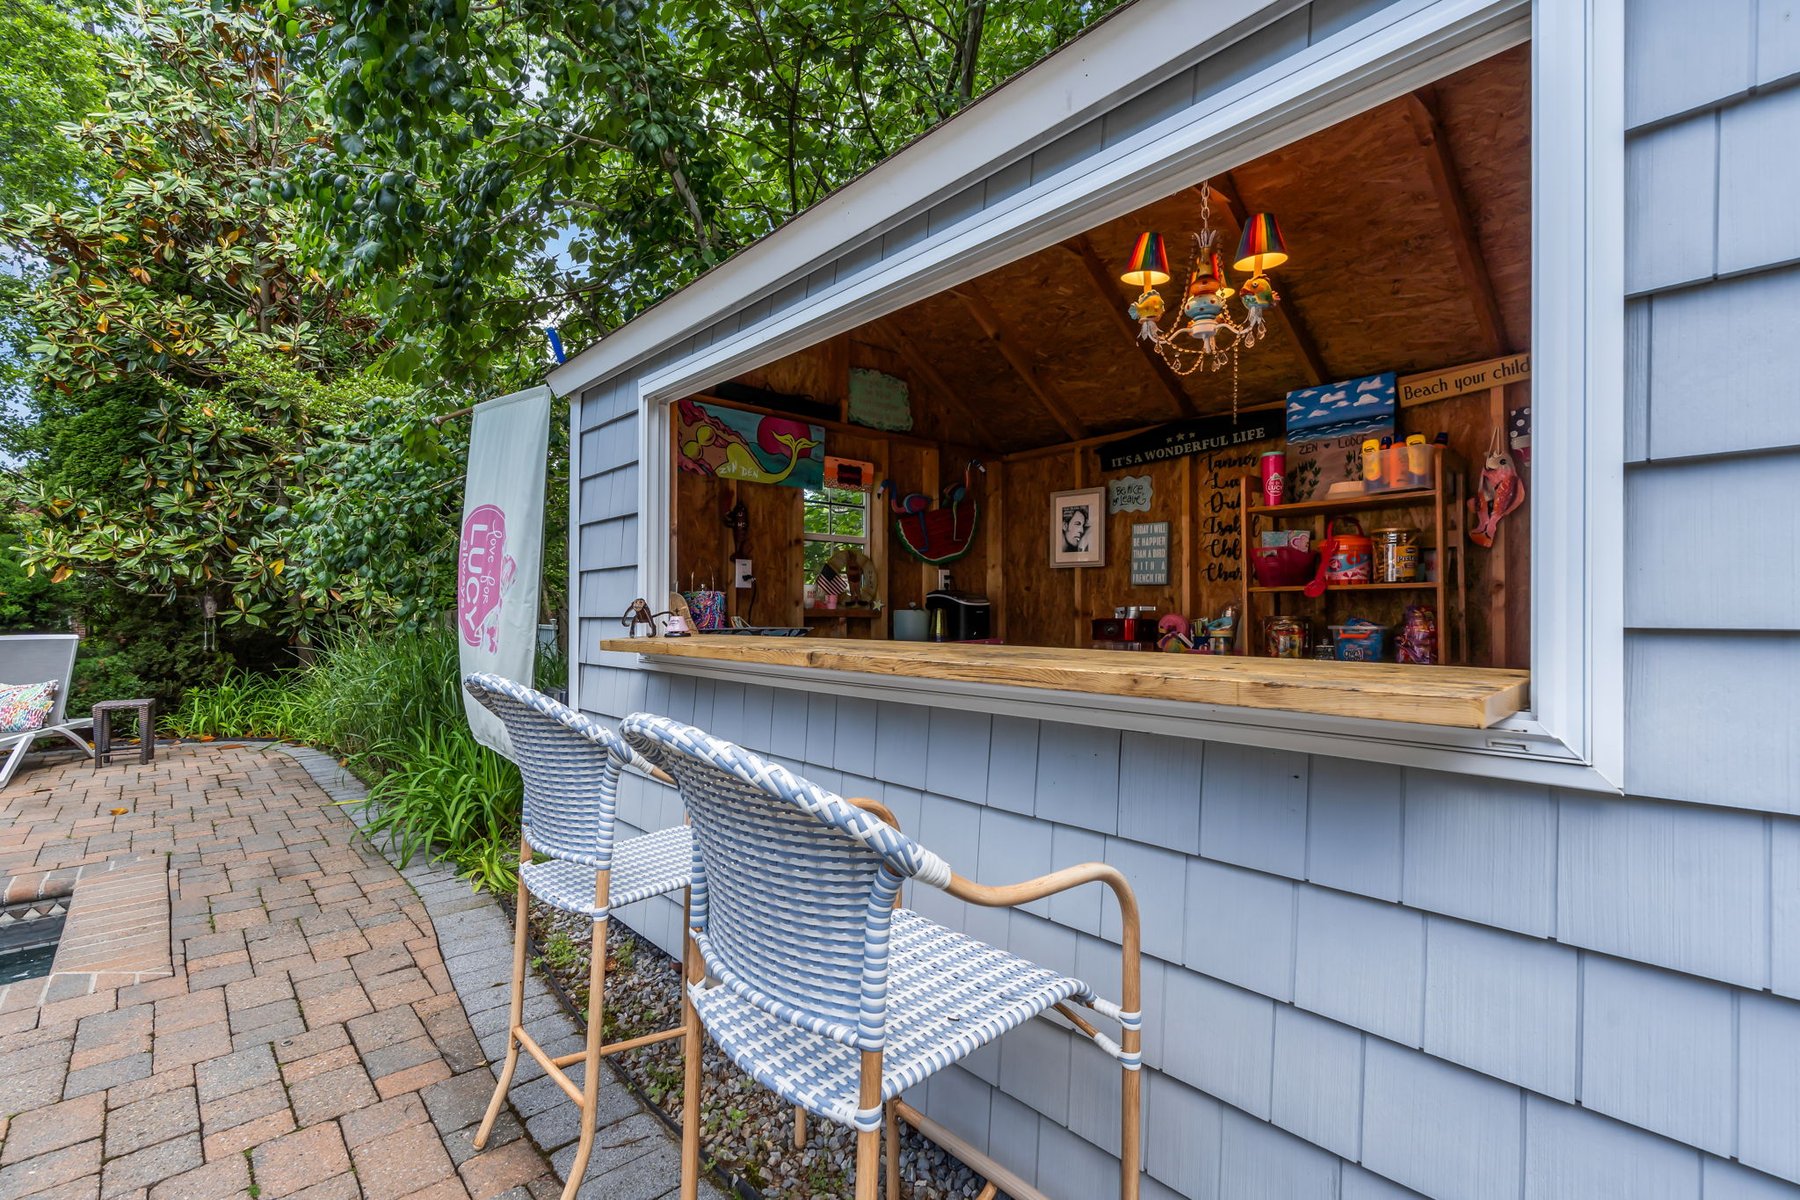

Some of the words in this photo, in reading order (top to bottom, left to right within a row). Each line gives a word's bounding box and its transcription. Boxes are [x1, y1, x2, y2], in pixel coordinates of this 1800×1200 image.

[1403, 378, 1448, 400] Beach
[1454, 371, 1486, 392] your
[1111, 455, 1132, 468] IT'S
[1134, 454, 1143, 464] A
[1144, 435, 1229, 461] WONDERFUL
[1232, 427, 1266, 443] LIFE
[1298, 442, 1318, 455] ZEN
[1133, 524, 1149, 535] TODAY
[1153, 523, 1166, 534] WILL
[1133, 537, 1140, 547] BE
[1141, 536, 1166, 547] HAPPIER
[1133, 549, 1147, 559] THAN
[1147, 549, 1152, 559] A
[1152, 548, 1166, 558] BIRD
[1133, 561, 1155, 571] WITH
[1161, 560, 1166, 570] A
[465, 524, 489, 632] LUCY
[1132, 573, 1154, 584] FRENCH
[1154, 573, 1166, 583] FRY
